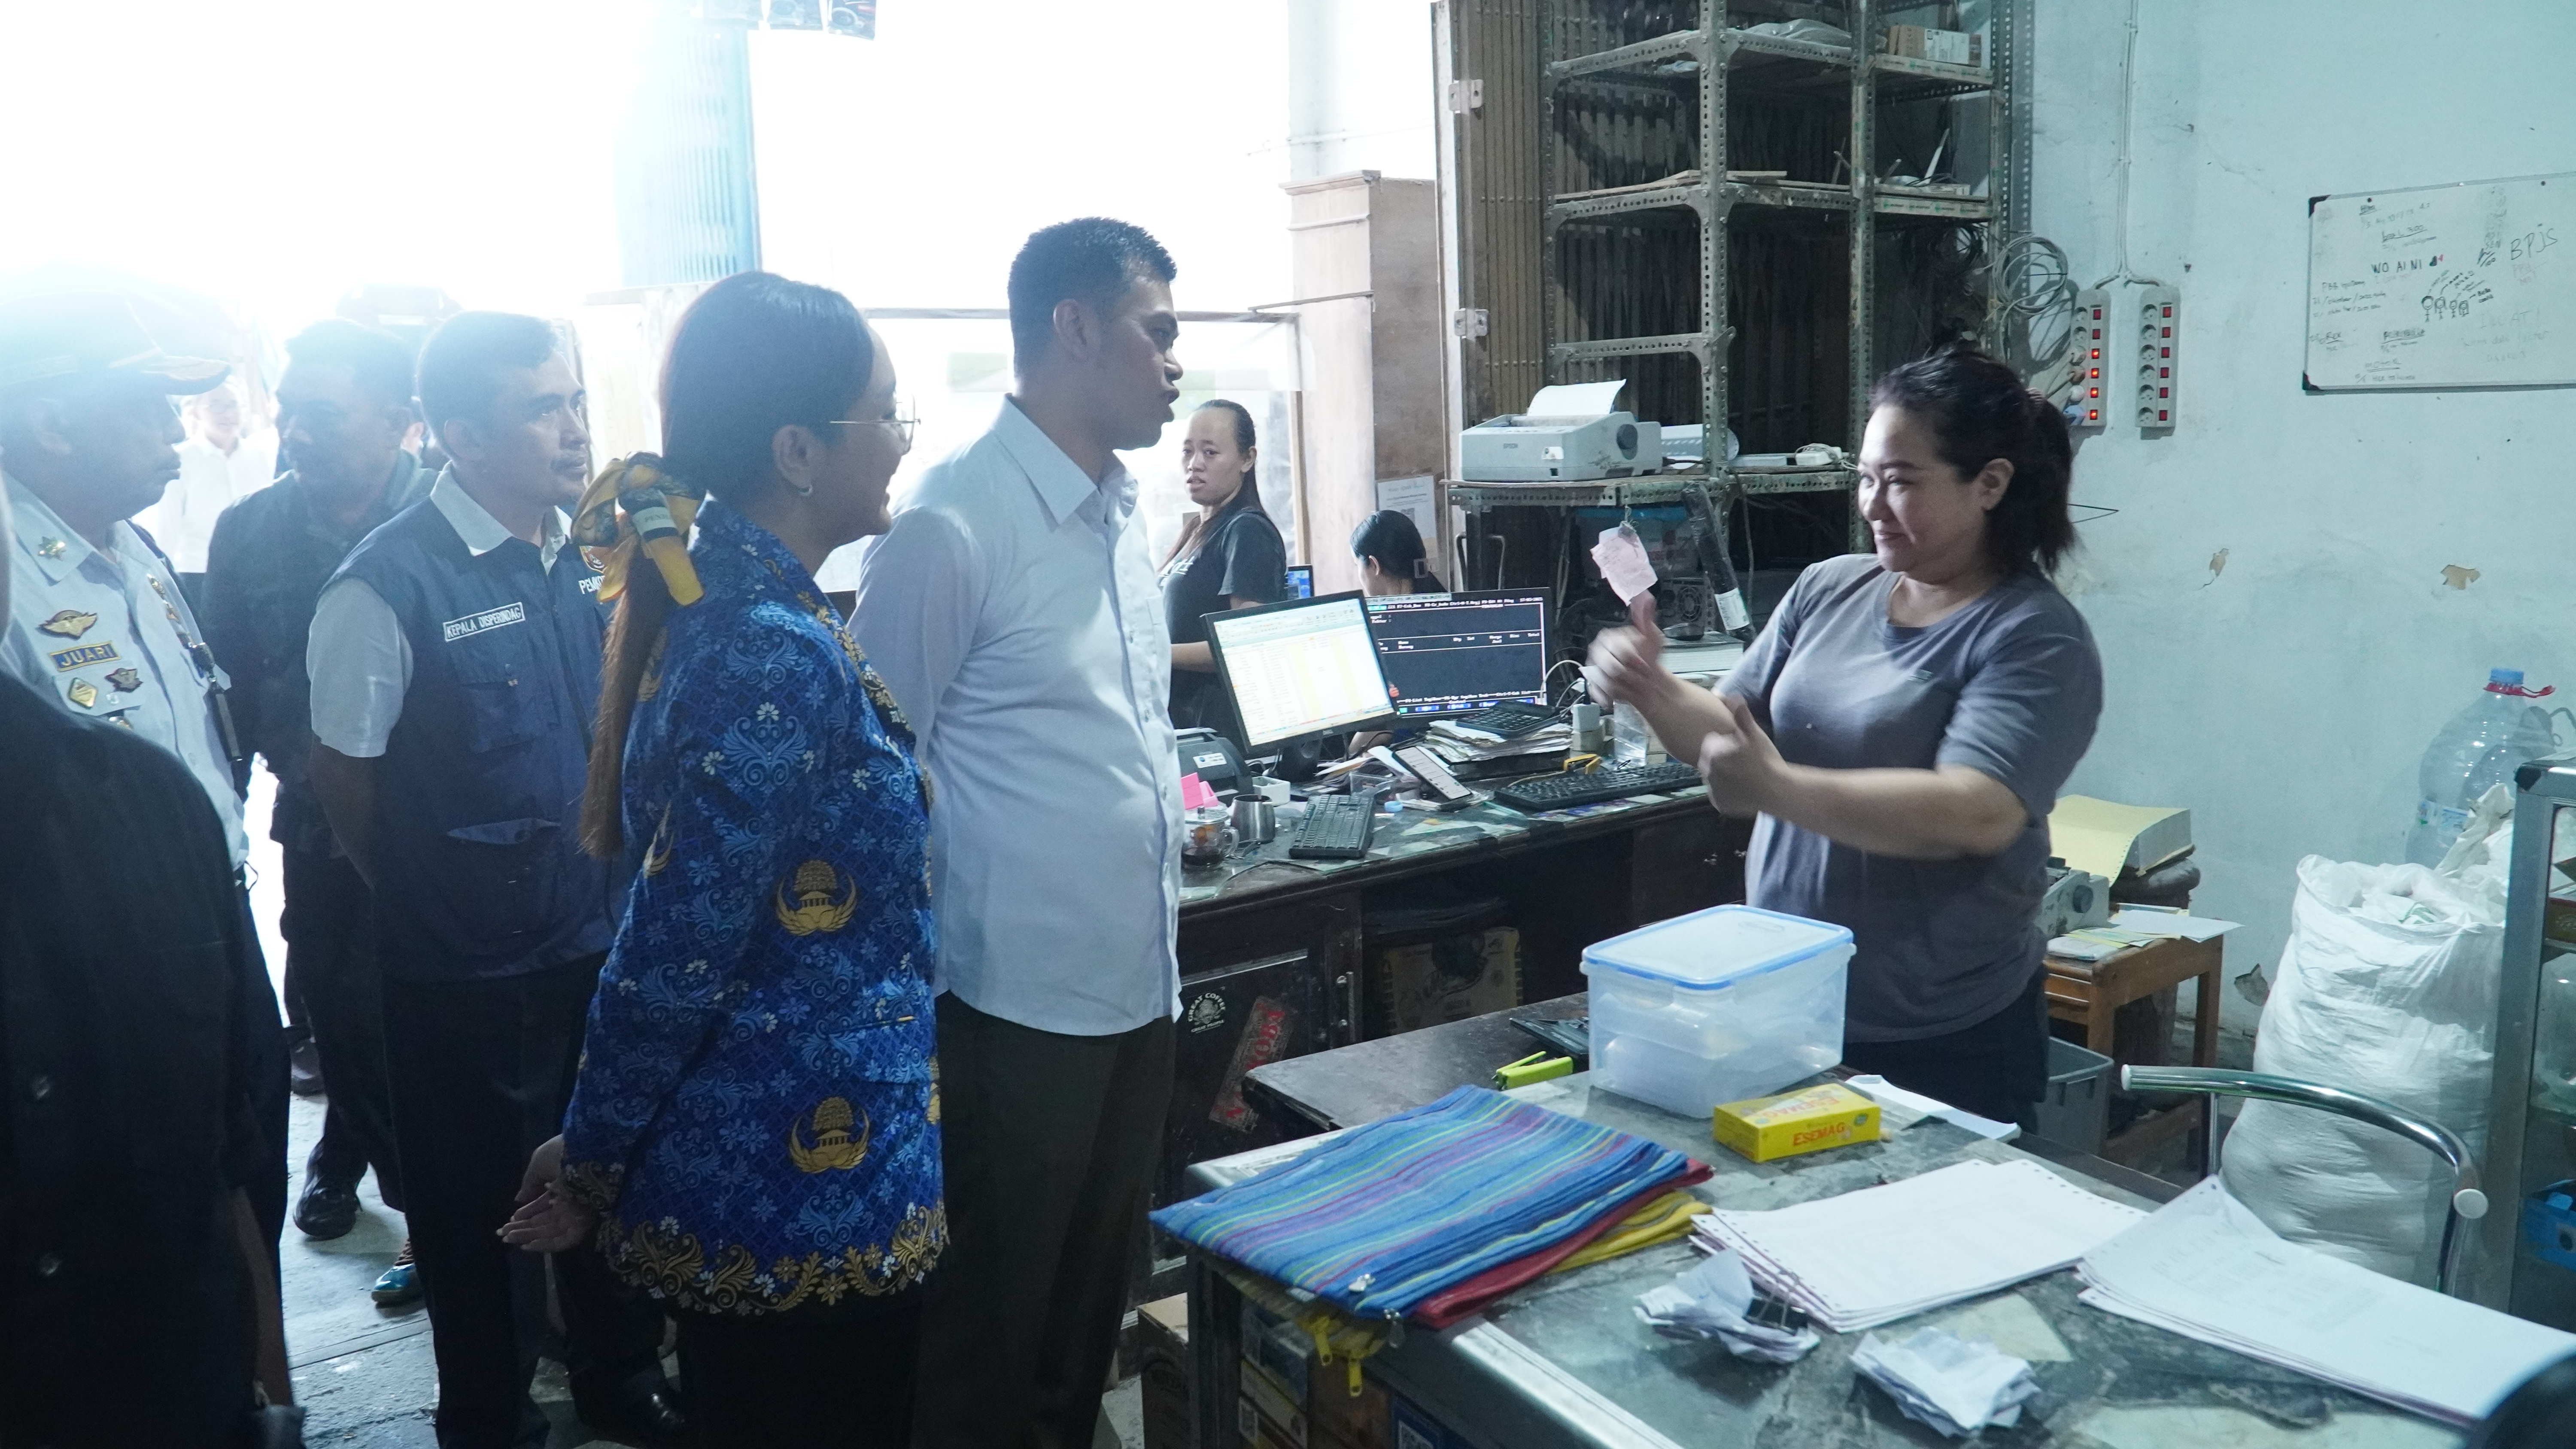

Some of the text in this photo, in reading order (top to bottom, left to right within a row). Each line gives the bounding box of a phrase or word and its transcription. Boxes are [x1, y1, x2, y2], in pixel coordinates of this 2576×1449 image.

[2371, 262, 2389, 273] WO
[446, 607, 522, 639] KEPALA DISPERINDAG
[61, 645, 114, 666] JUARI
[1188, 992, 1226, 1022] GREAT COFFEE
[1225, 1010, 1286, 1119] NKOBA
[1792, 1122, 1846, 1146] ESEMAG
